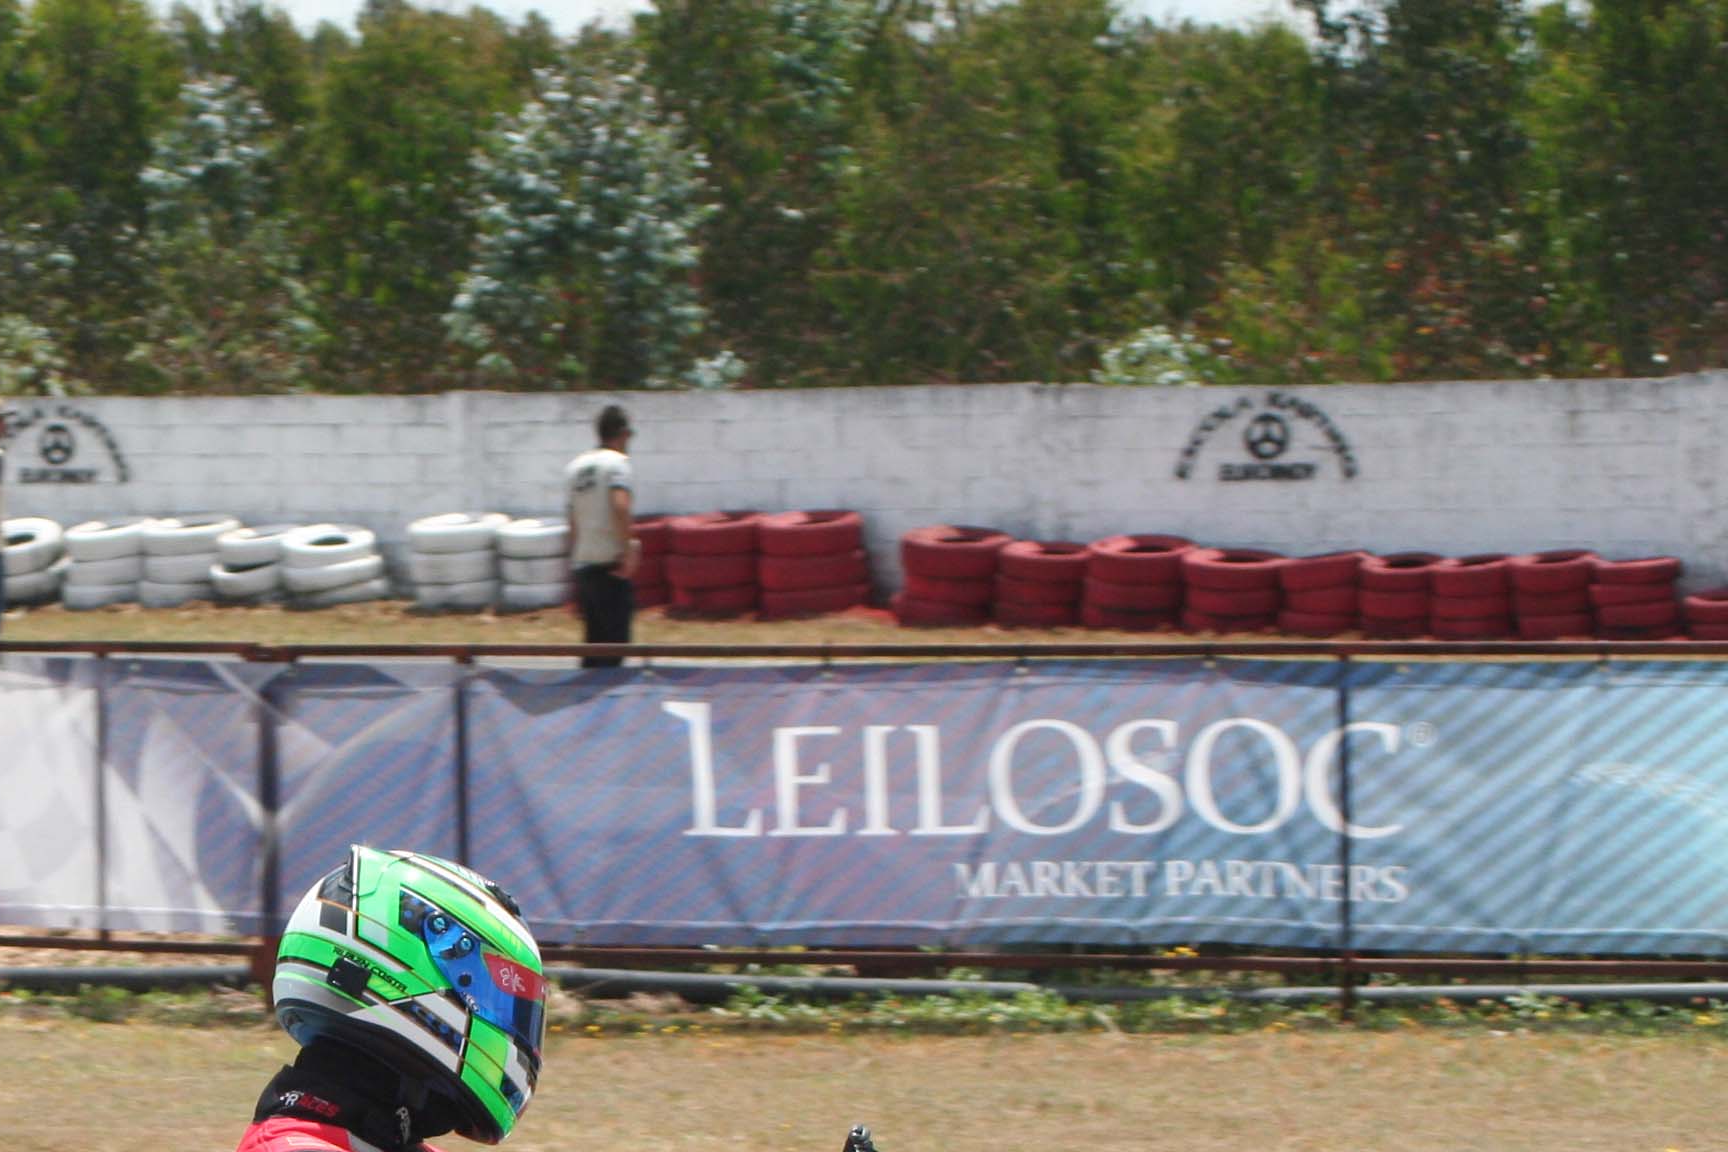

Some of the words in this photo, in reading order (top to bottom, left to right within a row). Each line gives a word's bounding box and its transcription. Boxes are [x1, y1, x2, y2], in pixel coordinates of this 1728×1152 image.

[662, 700, 1404, 838] LEILOSOC
[954, 861, 1155, 900] MARKET
[1165, 859, 1408, 903] PARTNERS
